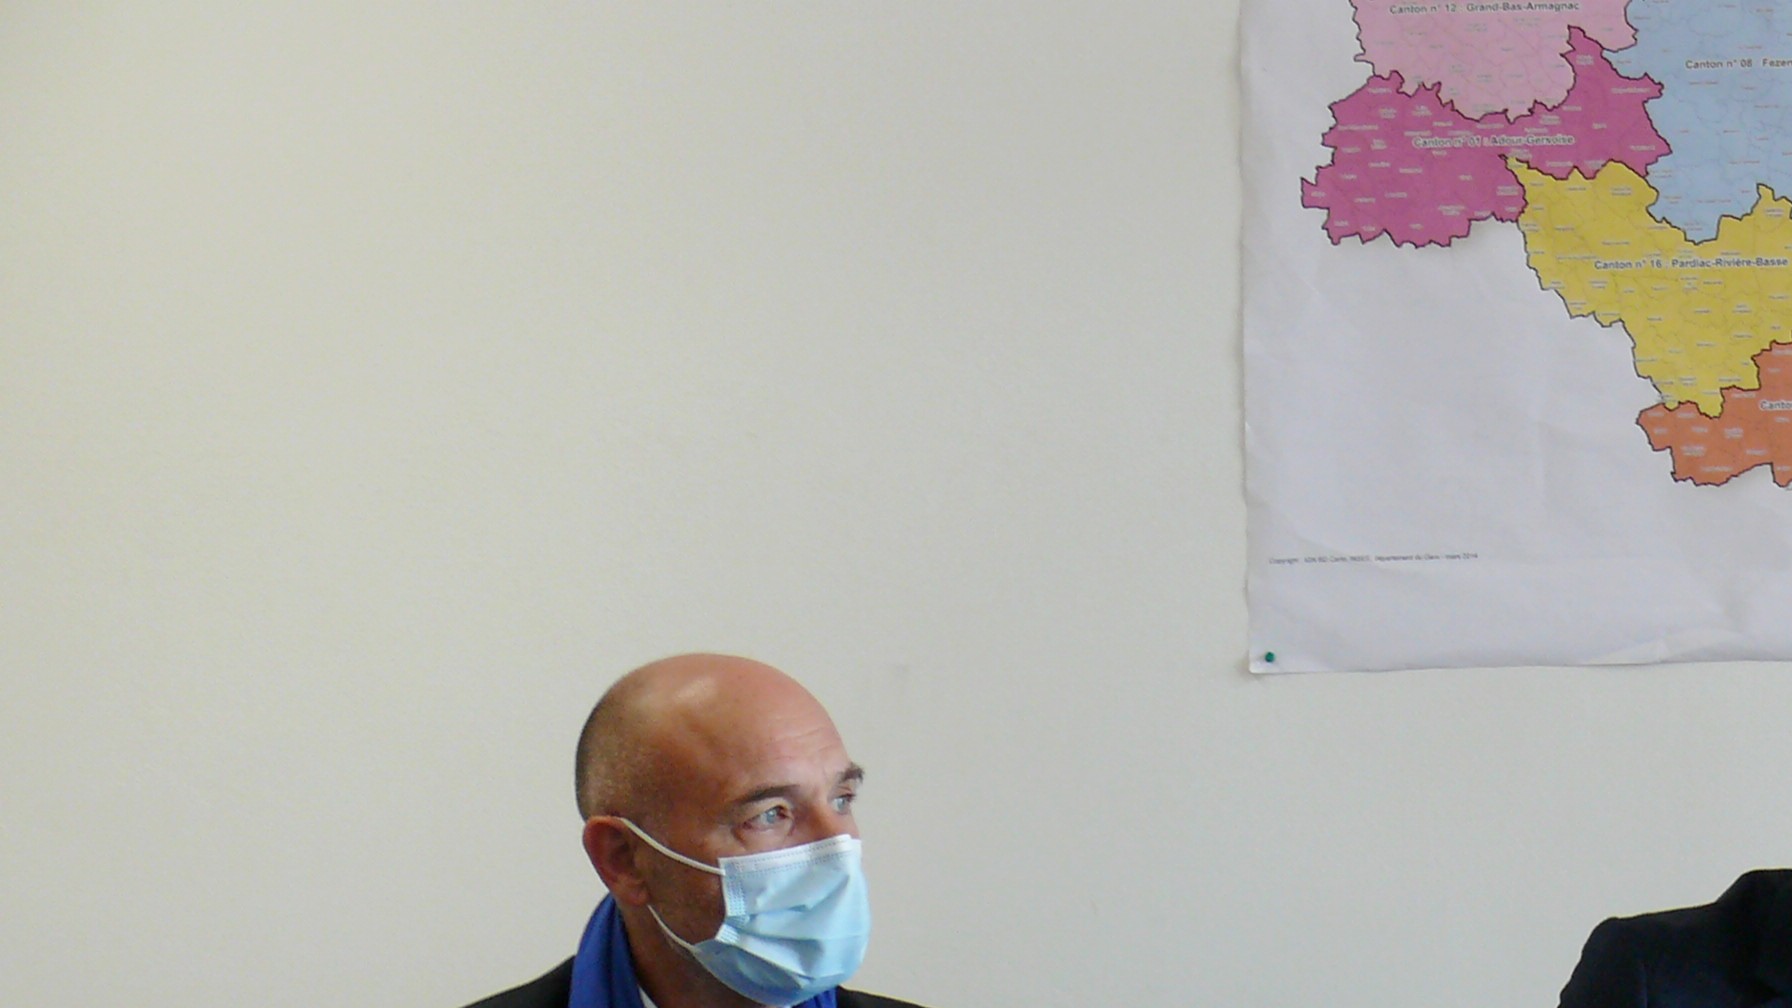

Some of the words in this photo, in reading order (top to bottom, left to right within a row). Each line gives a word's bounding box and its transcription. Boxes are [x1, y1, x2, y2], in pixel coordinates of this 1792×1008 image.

[1389, 5, 1428, 14] Canton
[1466, 2, 1580, 13] Grand-Bas-Armagnac
[1684, 59, 1724, 69] Canton
[1413, 137, 1452, 147] Canton
[1594, 260, 1633, 270] Canton
[1650, 259, 1662, 269] 16
